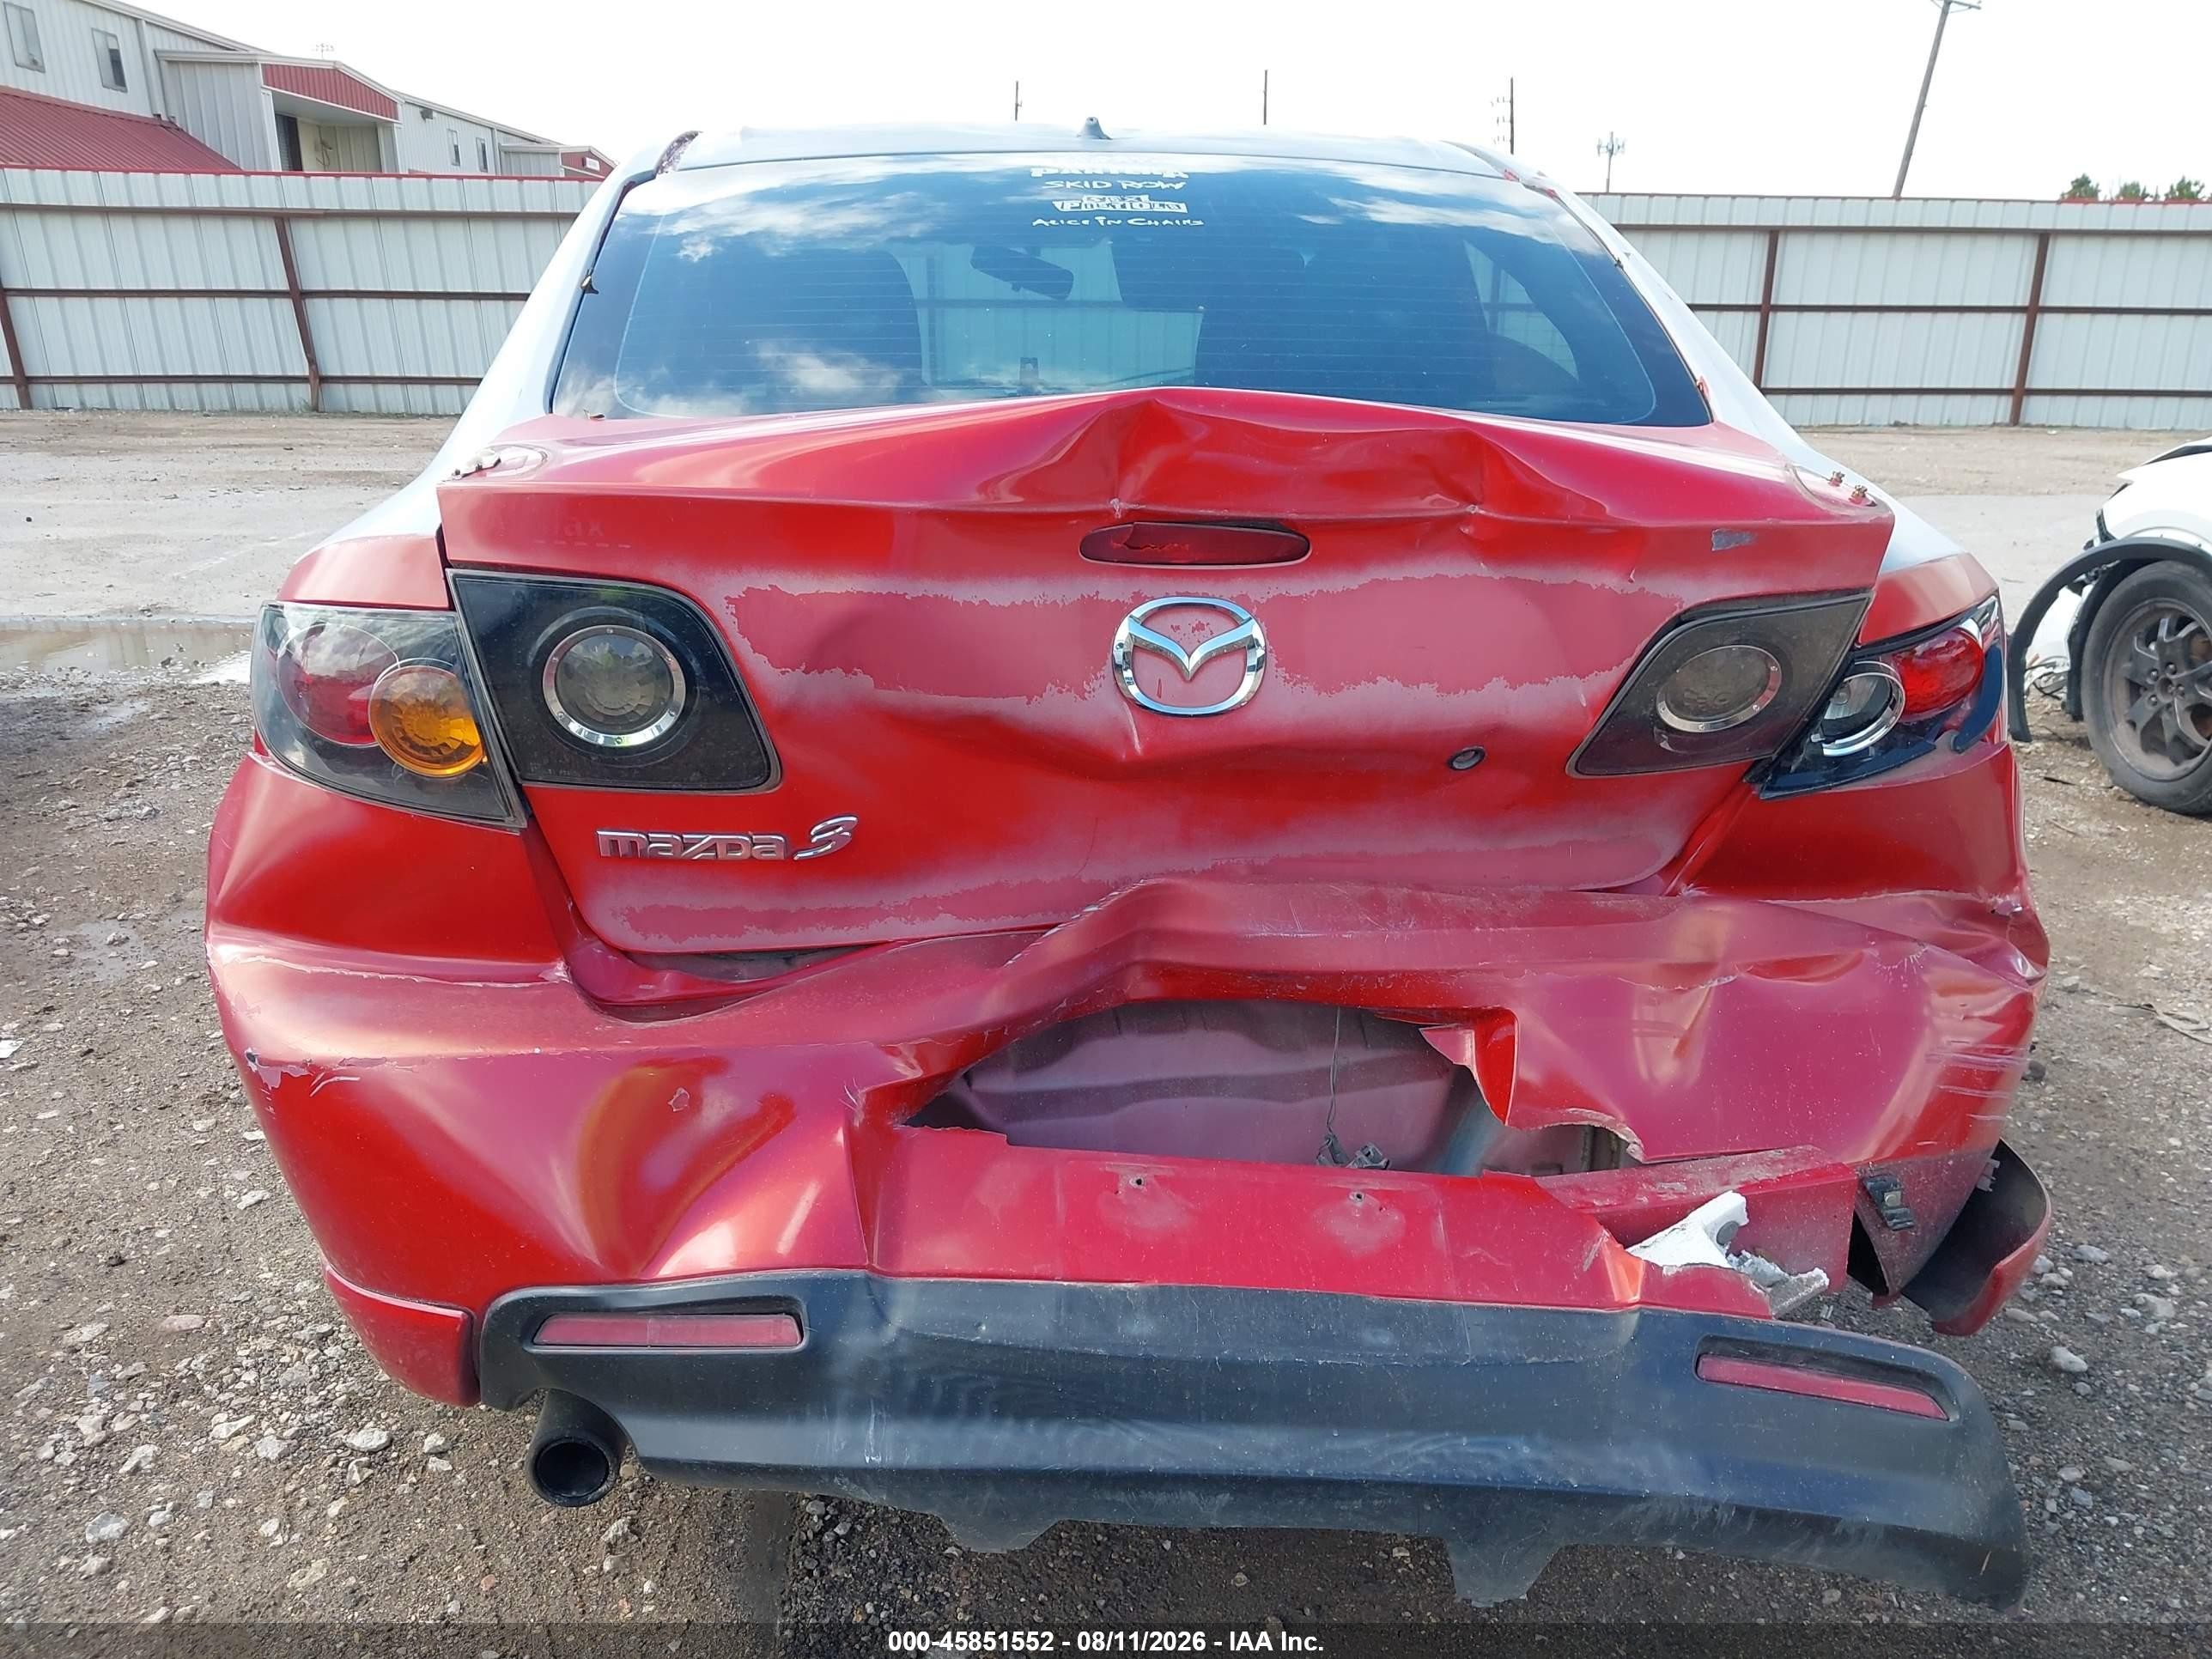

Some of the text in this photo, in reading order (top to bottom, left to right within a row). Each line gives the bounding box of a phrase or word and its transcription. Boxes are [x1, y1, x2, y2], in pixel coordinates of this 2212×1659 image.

[1042, 179, 1187, 190] SKID ROW
[793, 815, 858, 860] 3
